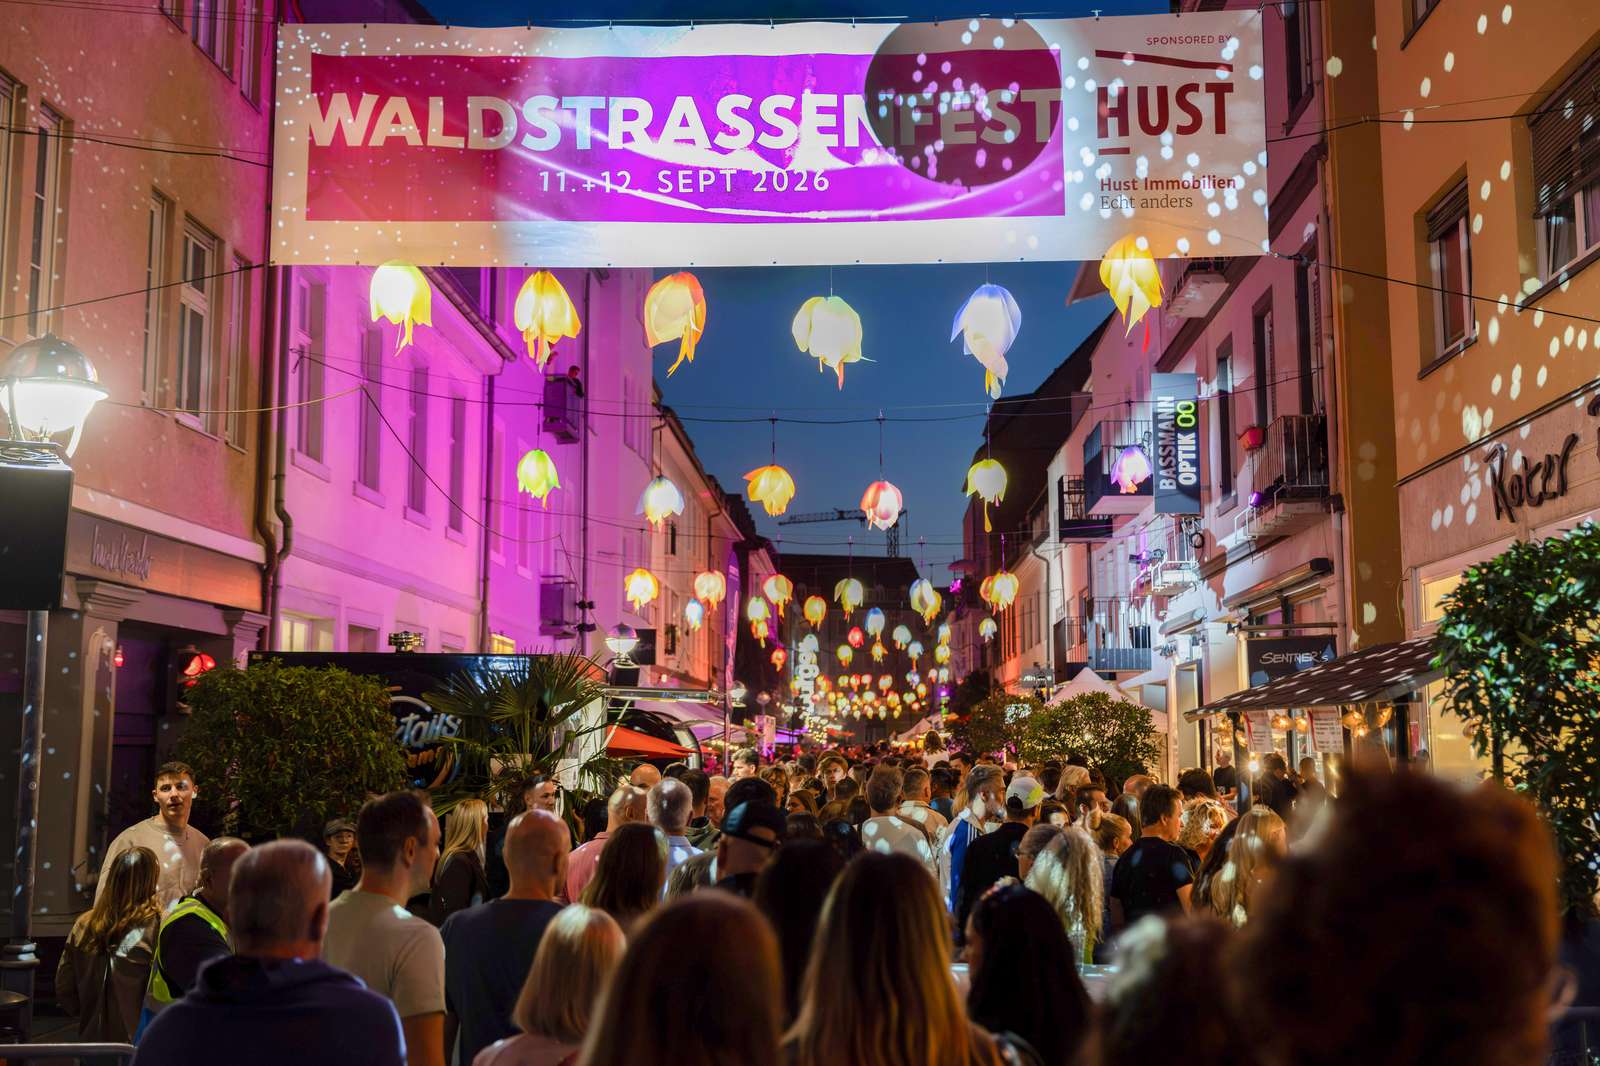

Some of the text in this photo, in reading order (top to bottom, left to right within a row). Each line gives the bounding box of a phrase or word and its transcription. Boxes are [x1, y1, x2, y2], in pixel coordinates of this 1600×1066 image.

[1146, 35, 1232, 45] SPONSORED BY
[309, 88, 1062, 151] WALDSTRASSENFEST
[1097, 82, 1234, 138] HUST
[657, 169, 737, 193] SEPT
[753, 168, 830, 193] 2026
[1100, 175, 1236, 192] Hust Immobilien
[1100, 194, 1193, 209] Echt anders
[1158, 396, 1177, 490] BASSMANN
[1177, 432, 1197, 486] OPTIK
[395, 713, 462, 749] tails
